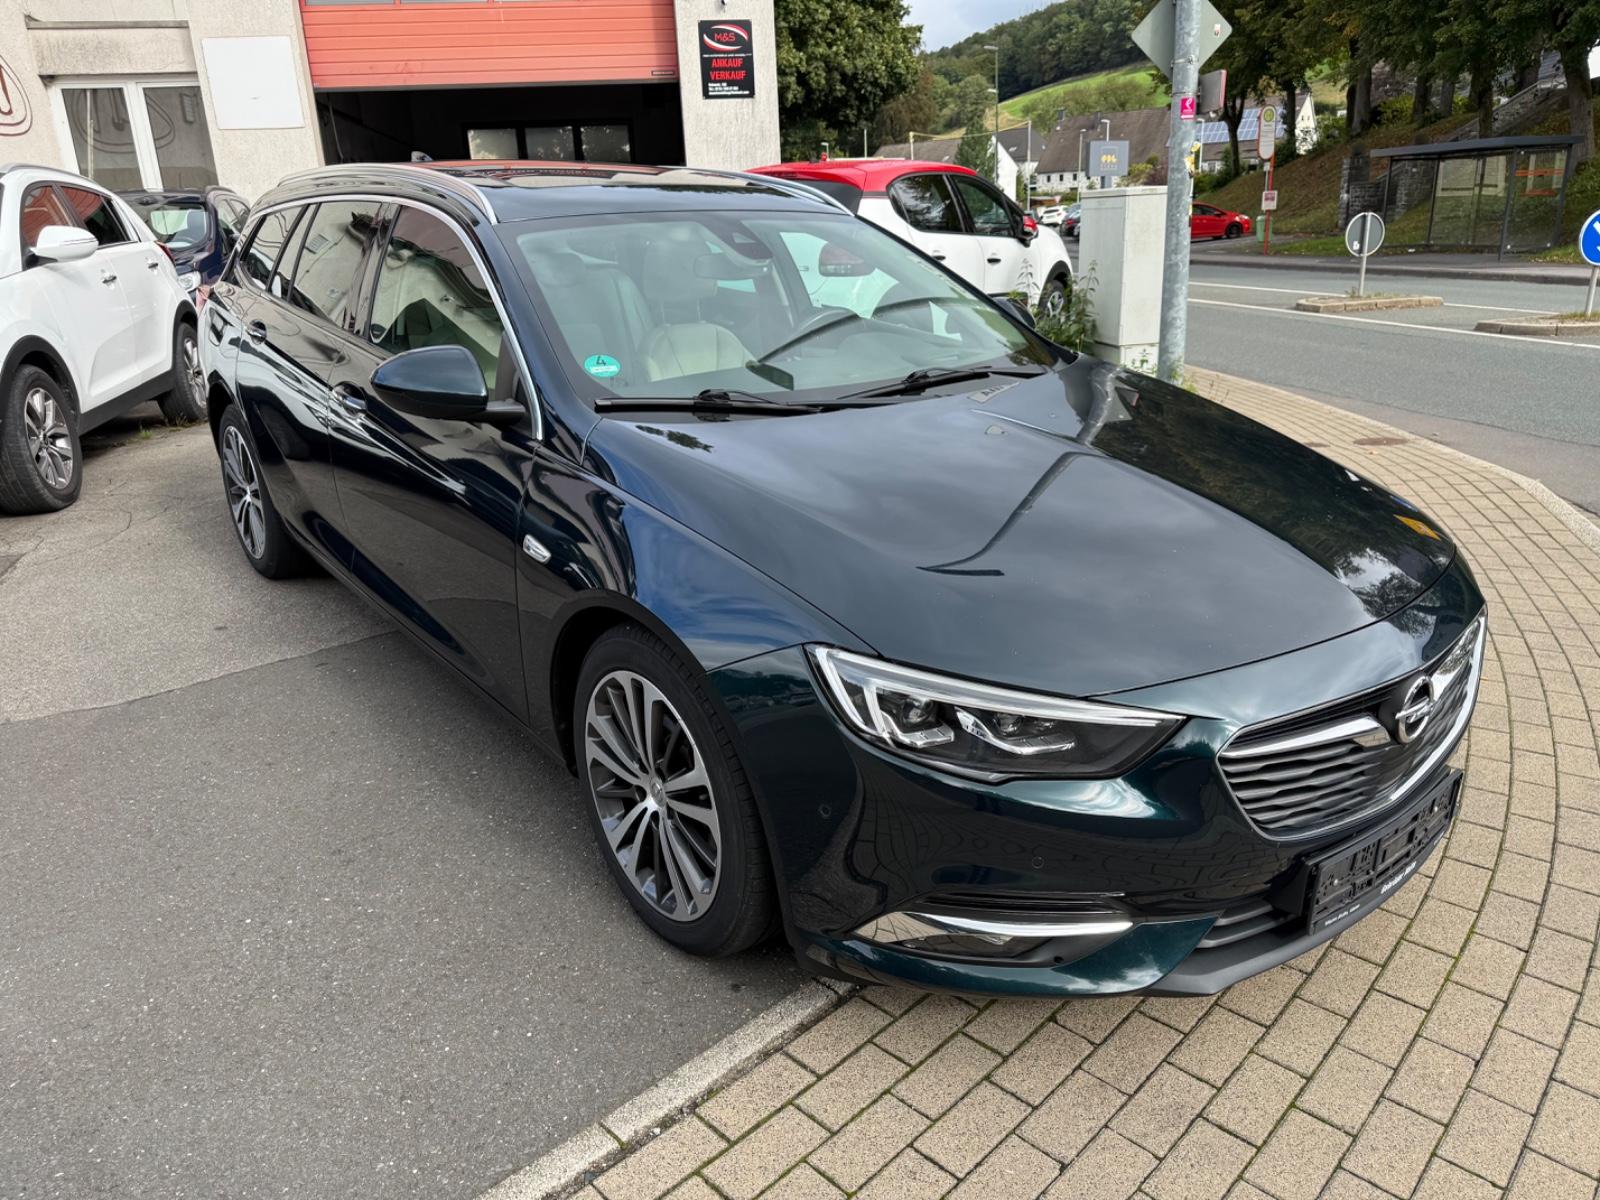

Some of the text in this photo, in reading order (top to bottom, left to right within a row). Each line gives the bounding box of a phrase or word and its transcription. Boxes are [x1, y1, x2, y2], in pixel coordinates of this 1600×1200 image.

[714, 32, 736, 42] M&S
[711, 58, 743, 67] ANKAUF
[710, 70, 747, 80] VERKAUF
[596, 355, 607, 366] 4
